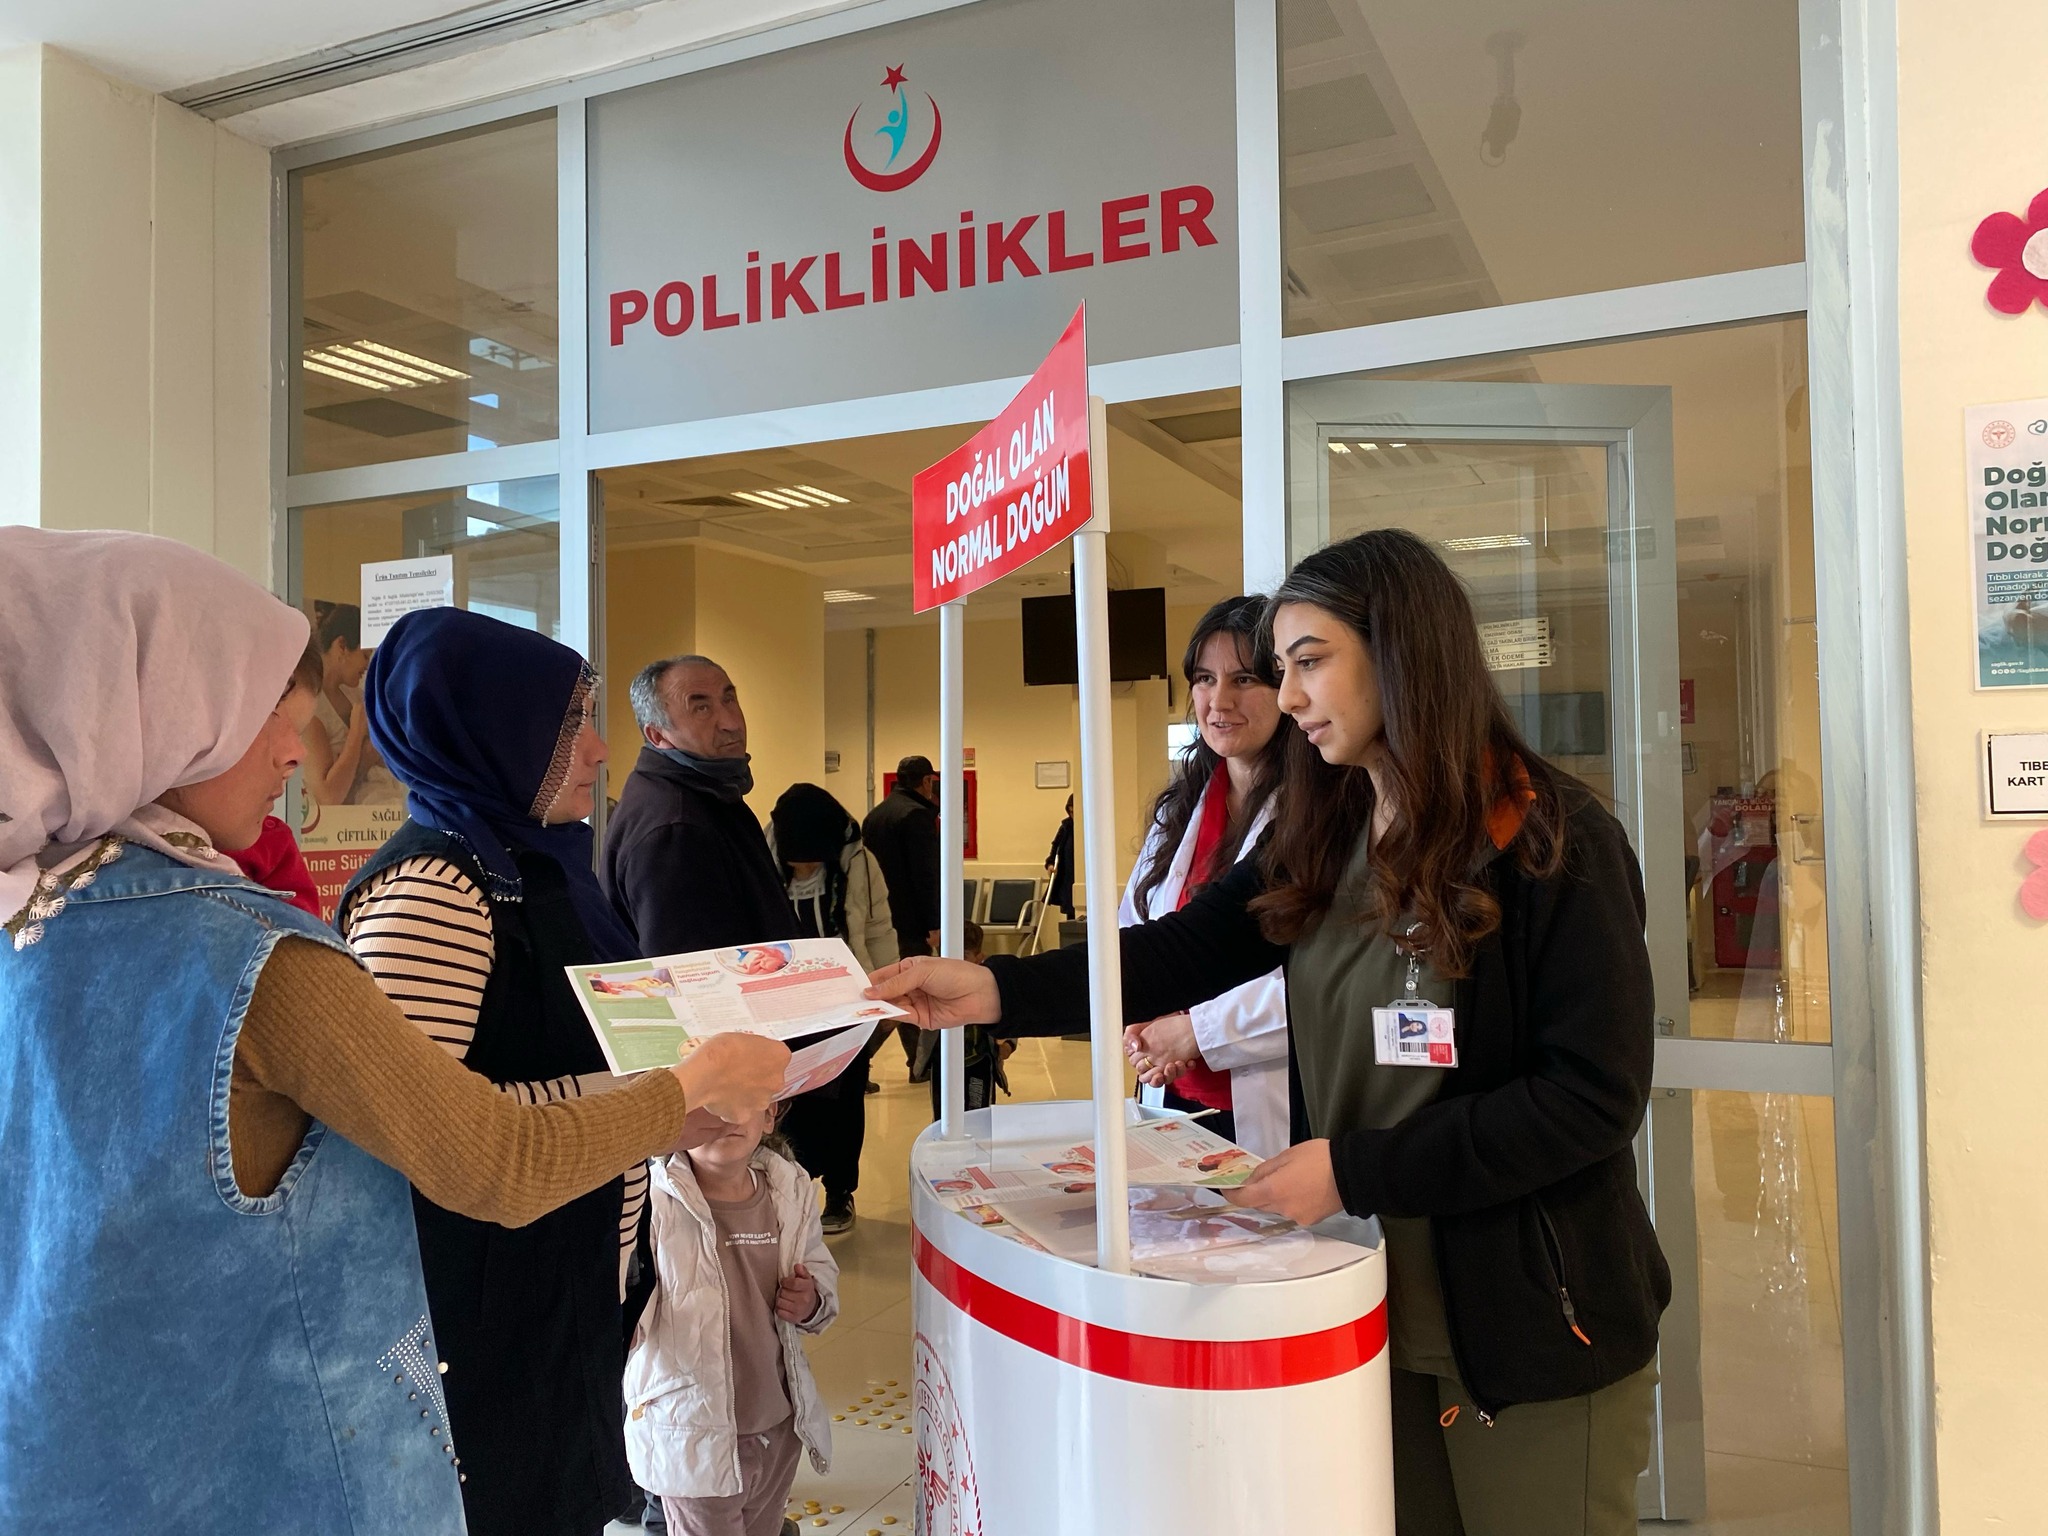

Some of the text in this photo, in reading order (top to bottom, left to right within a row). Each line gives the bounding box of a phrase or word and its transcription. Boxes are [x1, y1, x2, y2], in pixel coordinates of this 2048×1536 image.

[609, 185, 1218, 347] POLİKLİNİKLER
[946, 390, 1055, 525] DOĞAL OLAN
[1984, 461, 2046, 487] Doğ
[932, 456, 1070, 589] NORMAL DOĞUM
[1986, 516, 2048, 536] Nor
[1987, 537, 2048, 563] Doğ
[2013, 571, 2044, 580] olarak
[1988, 594, 2032, 603] sezaryen
[2007, 776, 2046, 787] KART
[1735, 804, 1771, 812] DOLABI
[337, 828, 377, 844] ÇİFTLİK
